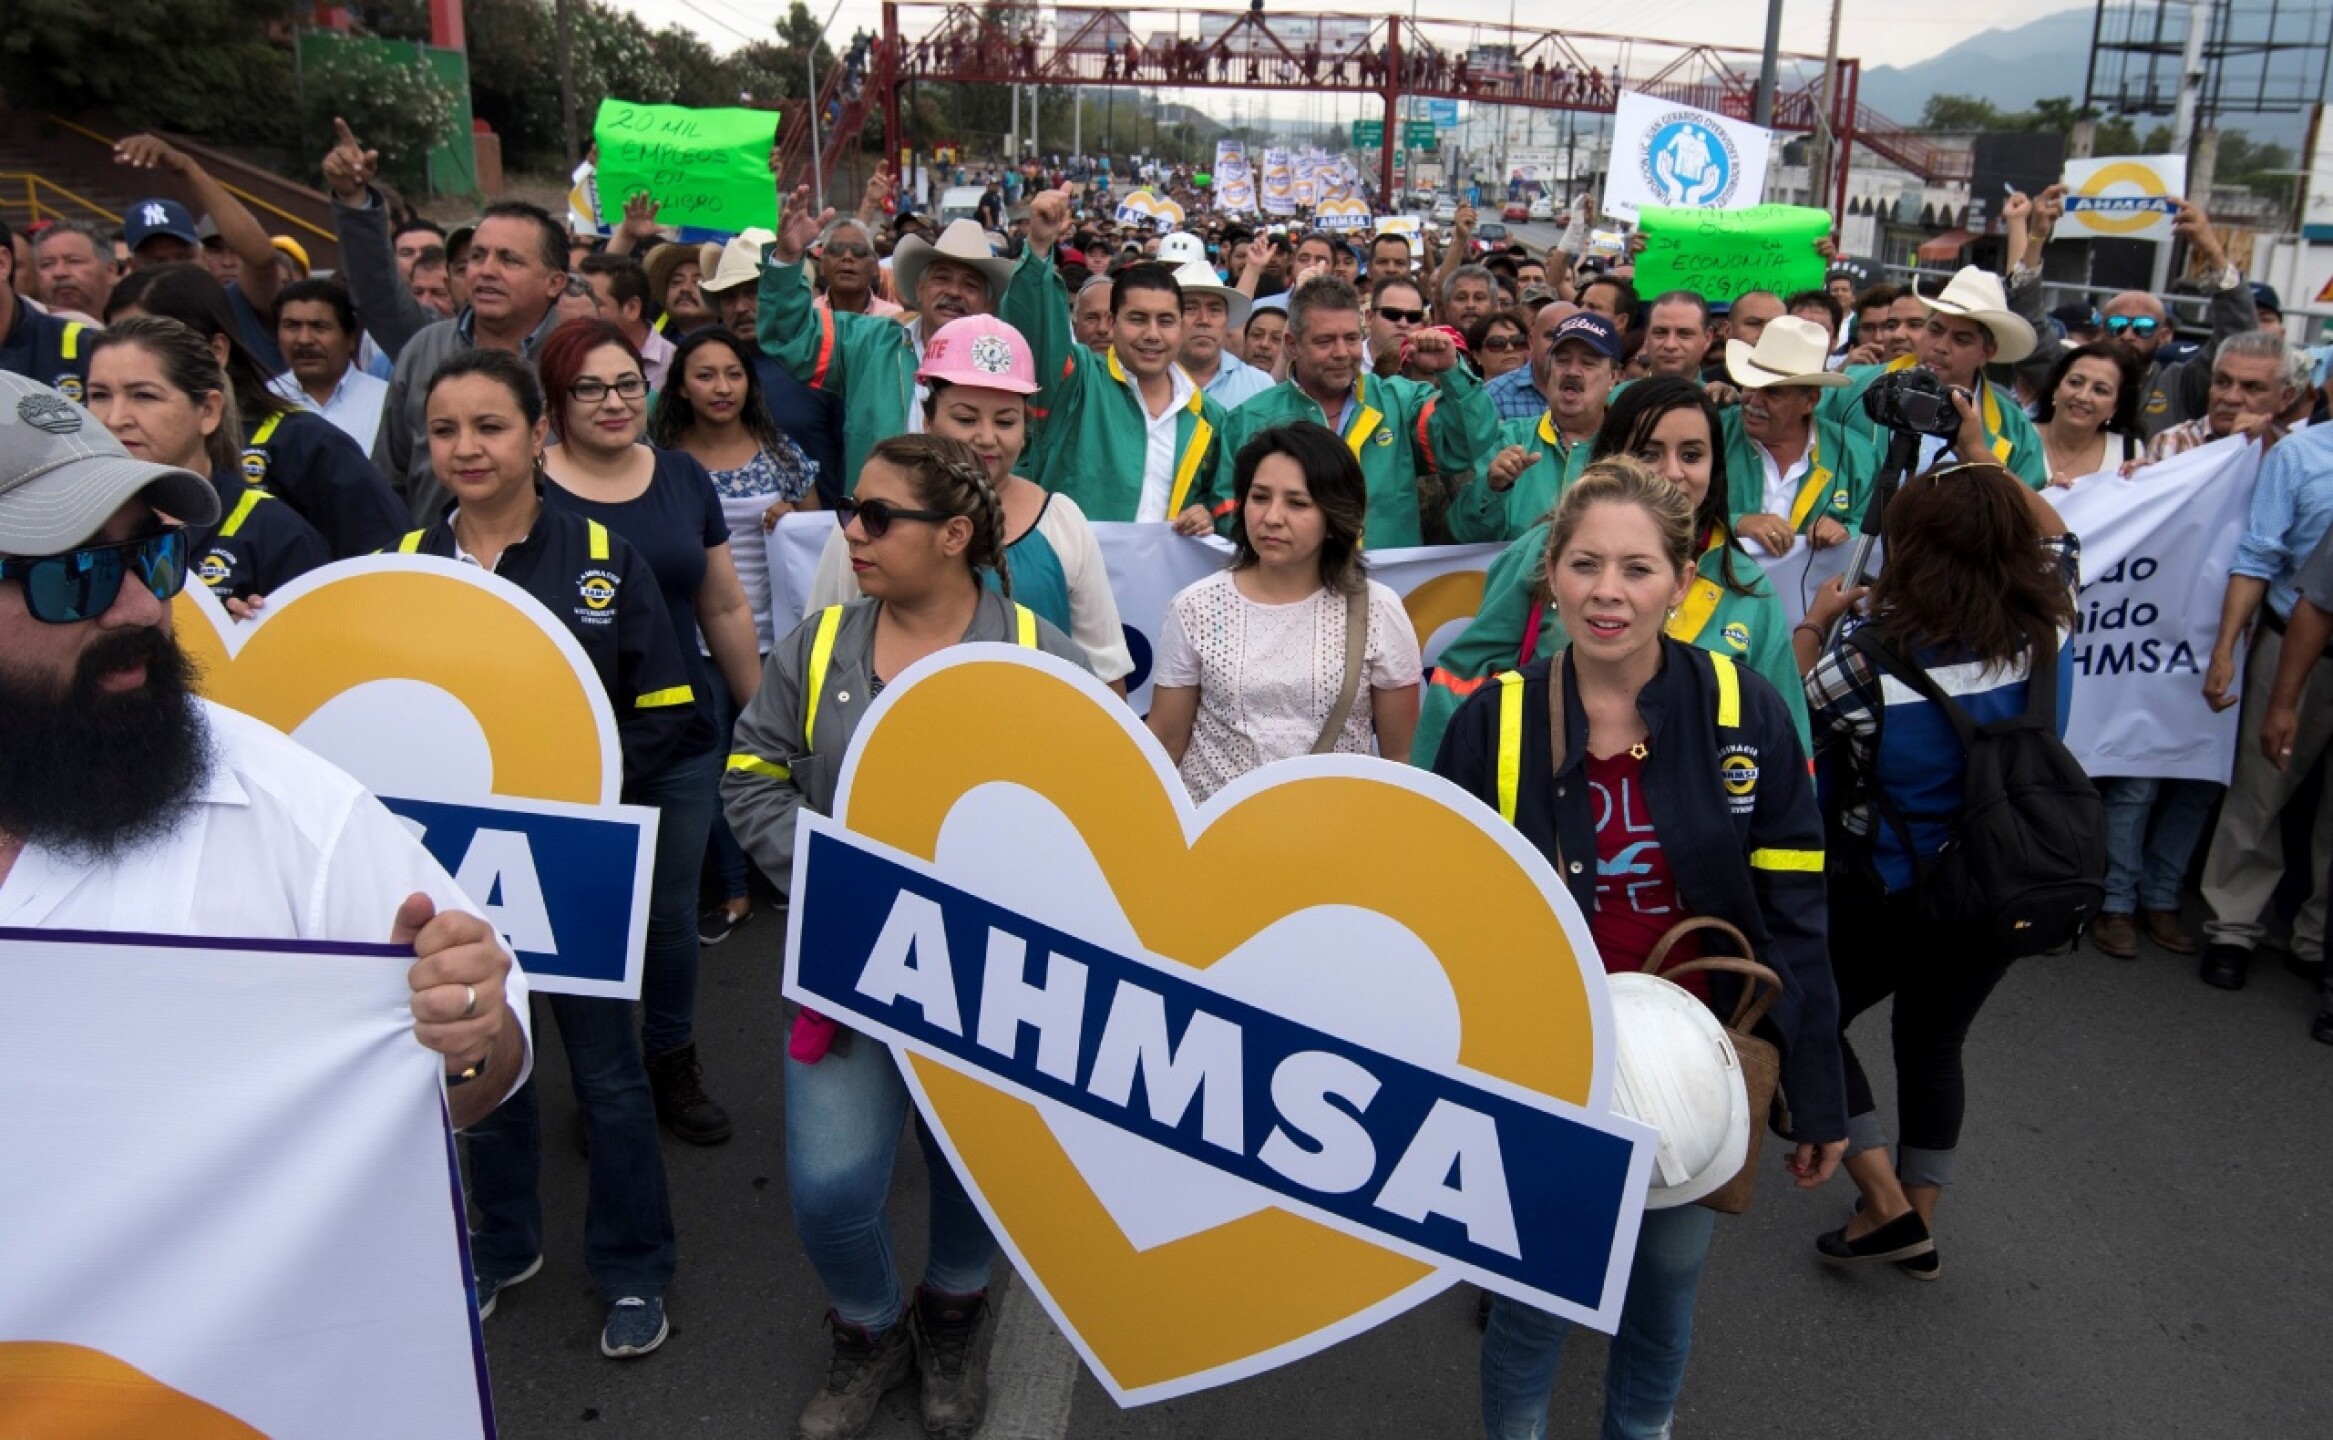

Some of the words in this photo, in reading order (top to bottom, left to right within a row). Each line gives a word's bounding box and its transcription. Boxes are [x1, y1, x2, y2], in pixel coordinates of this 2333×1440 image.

[609, 109, 655, 130] 20
[661, 121, 702, 138] MIL
[621, 140, 731, 164] EMPLEOS
[653, 168, 685, 185] EN
[2074, 198, 2168, 211] AHMSA
[856, 889, 1522, 1260] AHMSA
